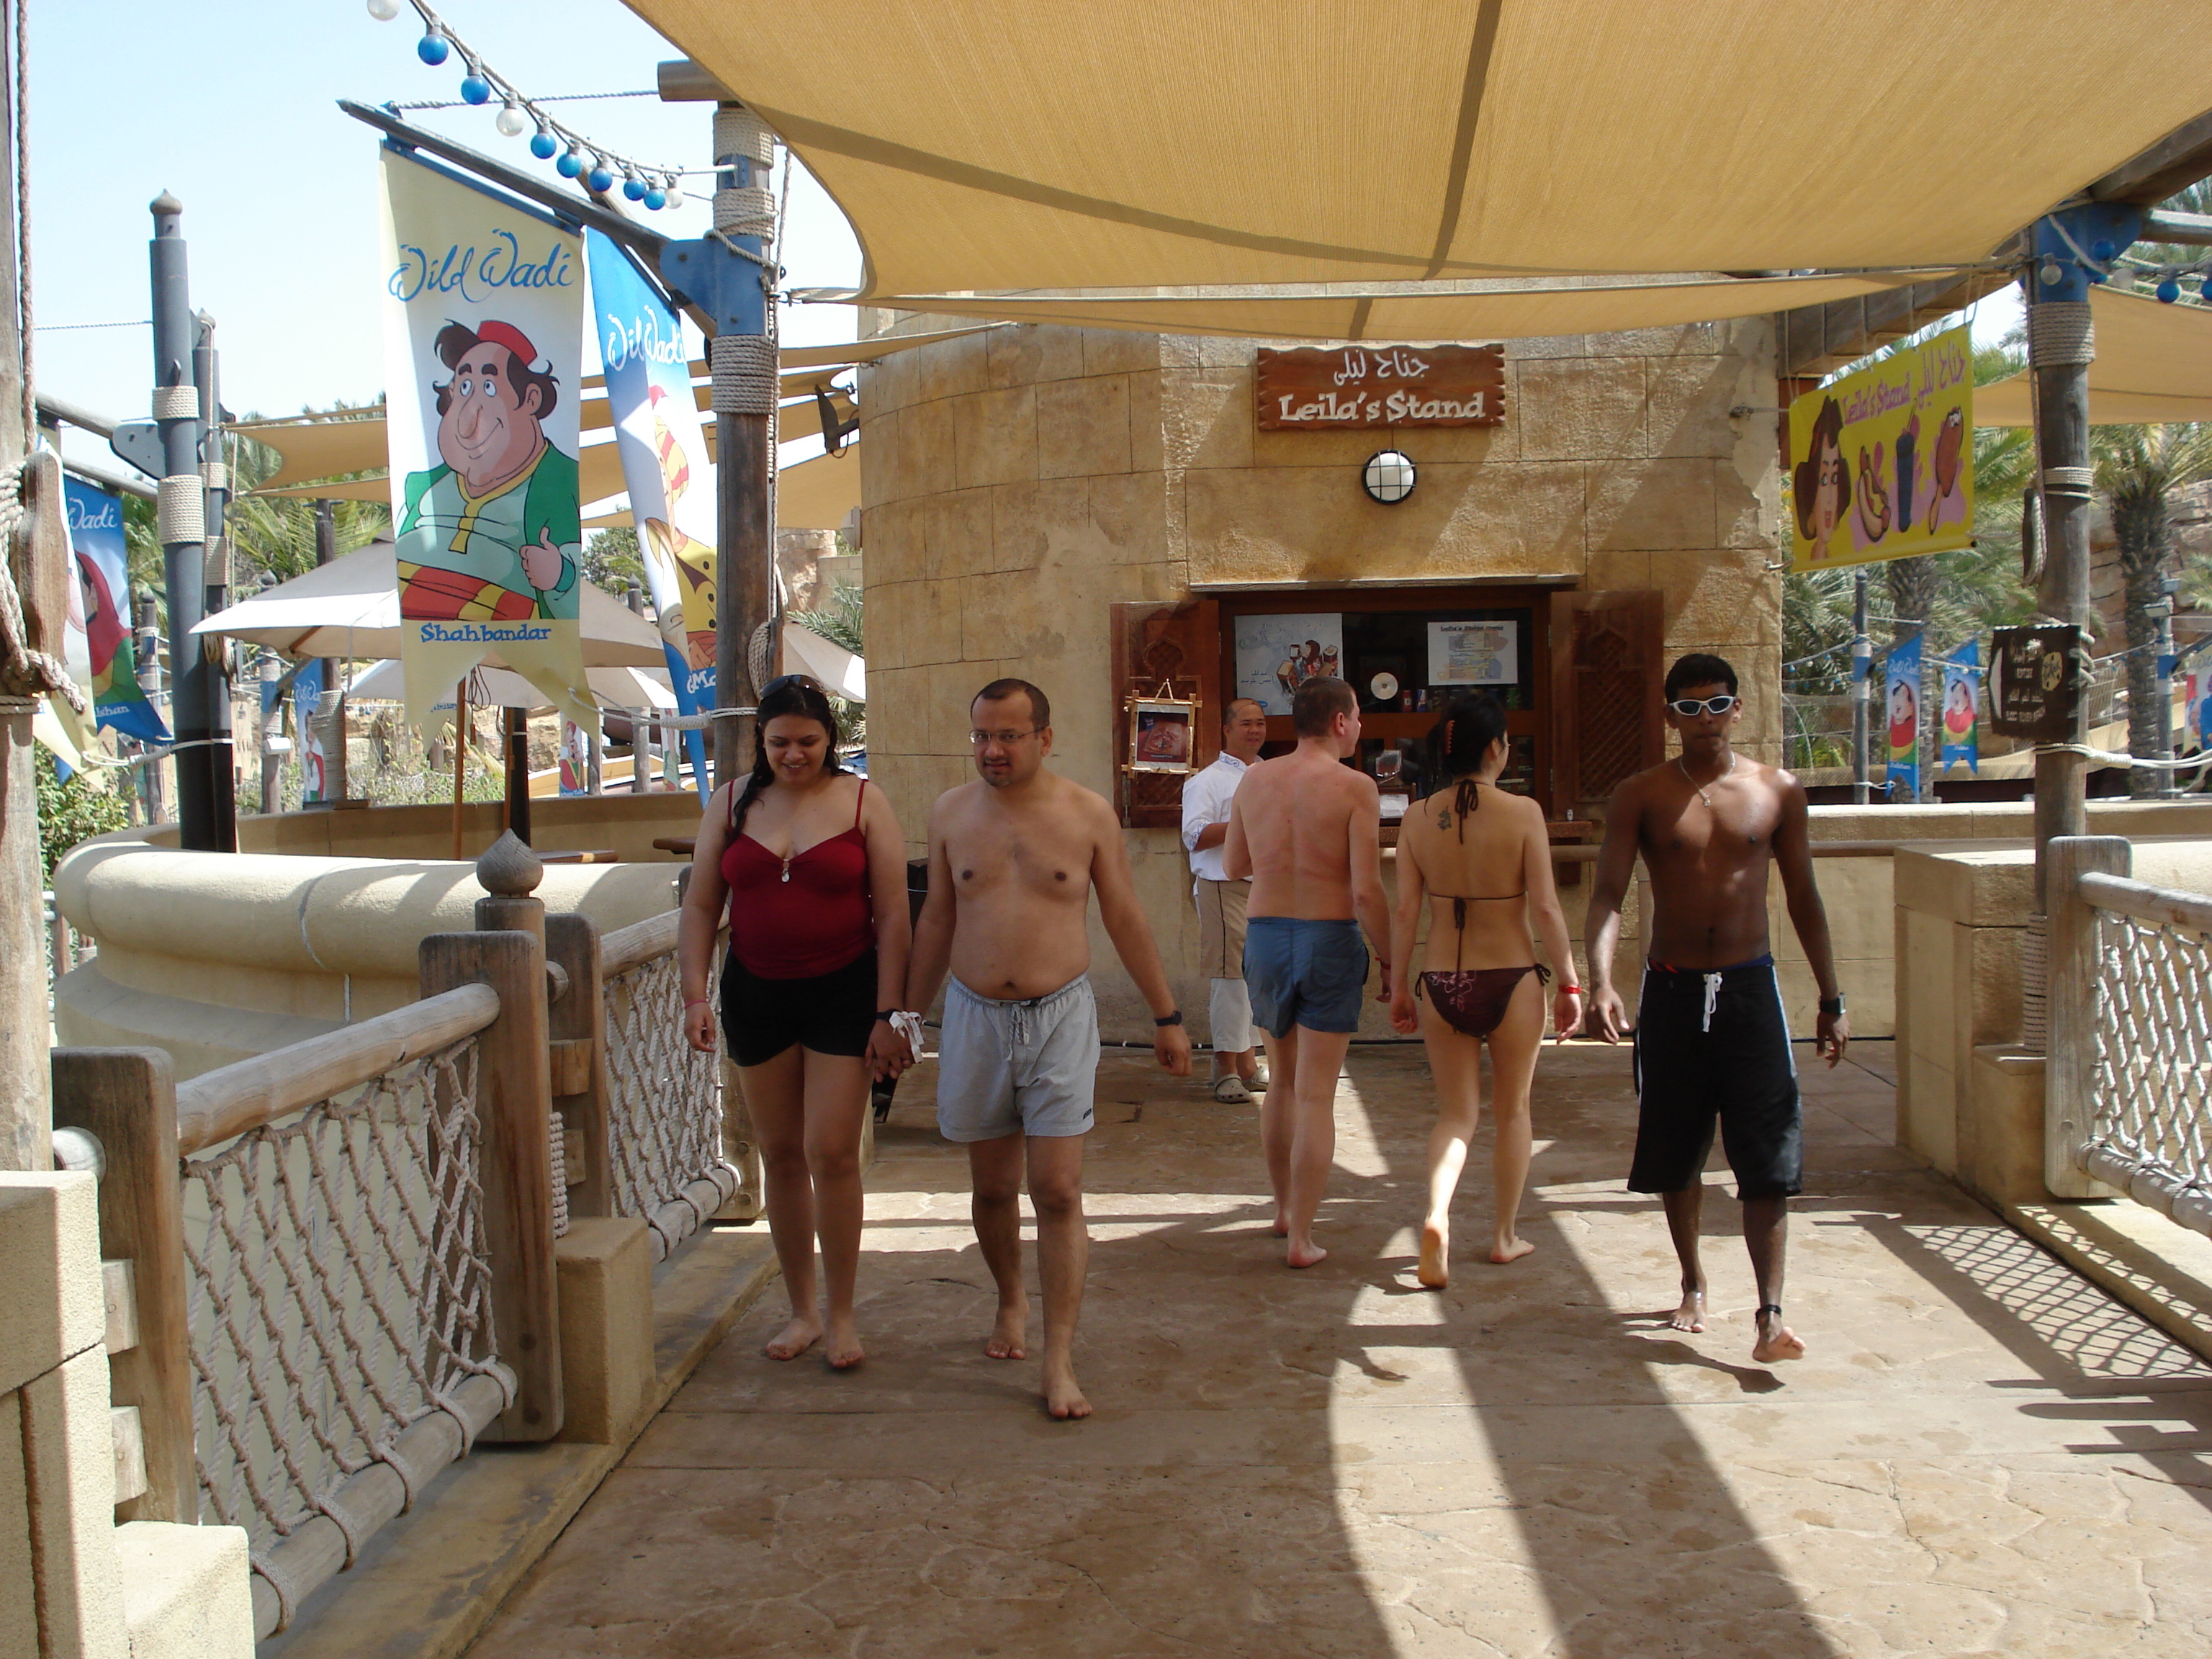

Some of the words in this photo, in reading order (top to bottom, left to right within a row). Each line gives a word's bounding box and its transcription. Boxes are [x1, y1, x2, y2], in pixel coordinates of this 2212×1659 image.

[388, 244, 494, 302] Wild
[479, 228, 575, 288] Wadi
[644, 305, 686, 365] Wadi
[1373, 350, 1430, 379] جناح
[1278, 391, 1381, 422] Leila's
[1386, 389, 1487, 422] Stand
[68, 497, 118, 530] Wadi
[421, 622, 552, 643] Shahbandar
